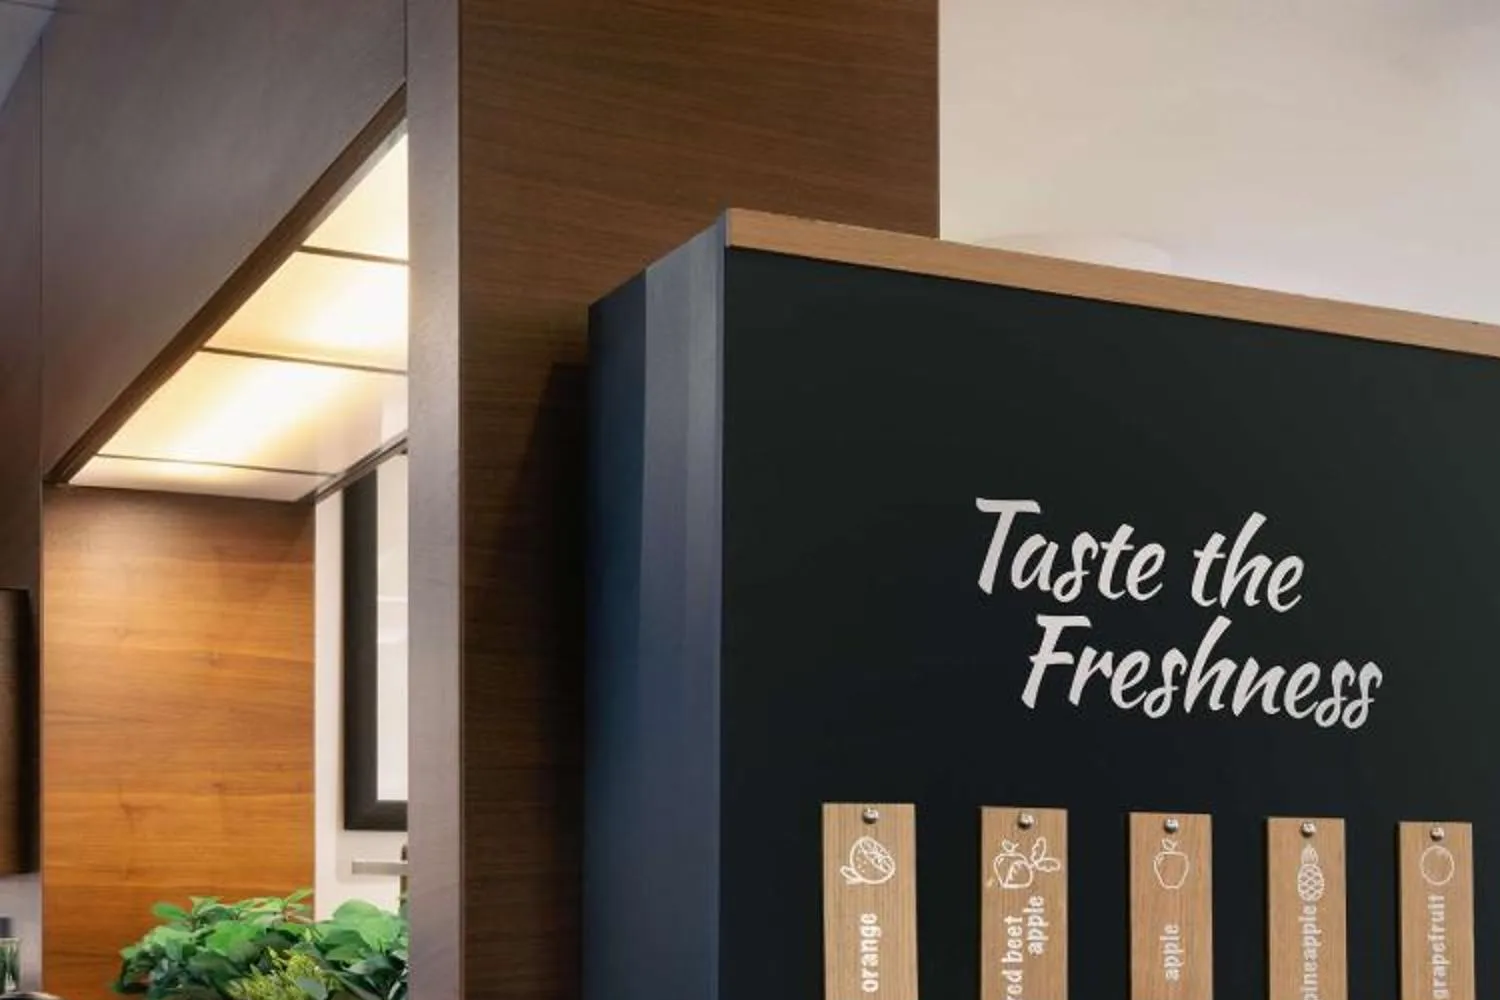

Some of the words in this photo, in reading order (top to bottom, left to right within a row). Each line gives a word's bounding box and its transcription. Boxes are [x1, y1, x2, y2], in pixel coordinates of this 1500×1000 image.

[975, 497, 1166, 603] Taste
[1191, 511, 1305, 613] the
[1021, 613, 1383, 730] Freshness
[859, 912, 883, 993] orange
[1001, 915, 1023, 964] beet
[1023, 895, 1049, 956] apple
[1159, 924, 1184, 982] apple
[1427, 894, 1450, 1000] grapefruit
